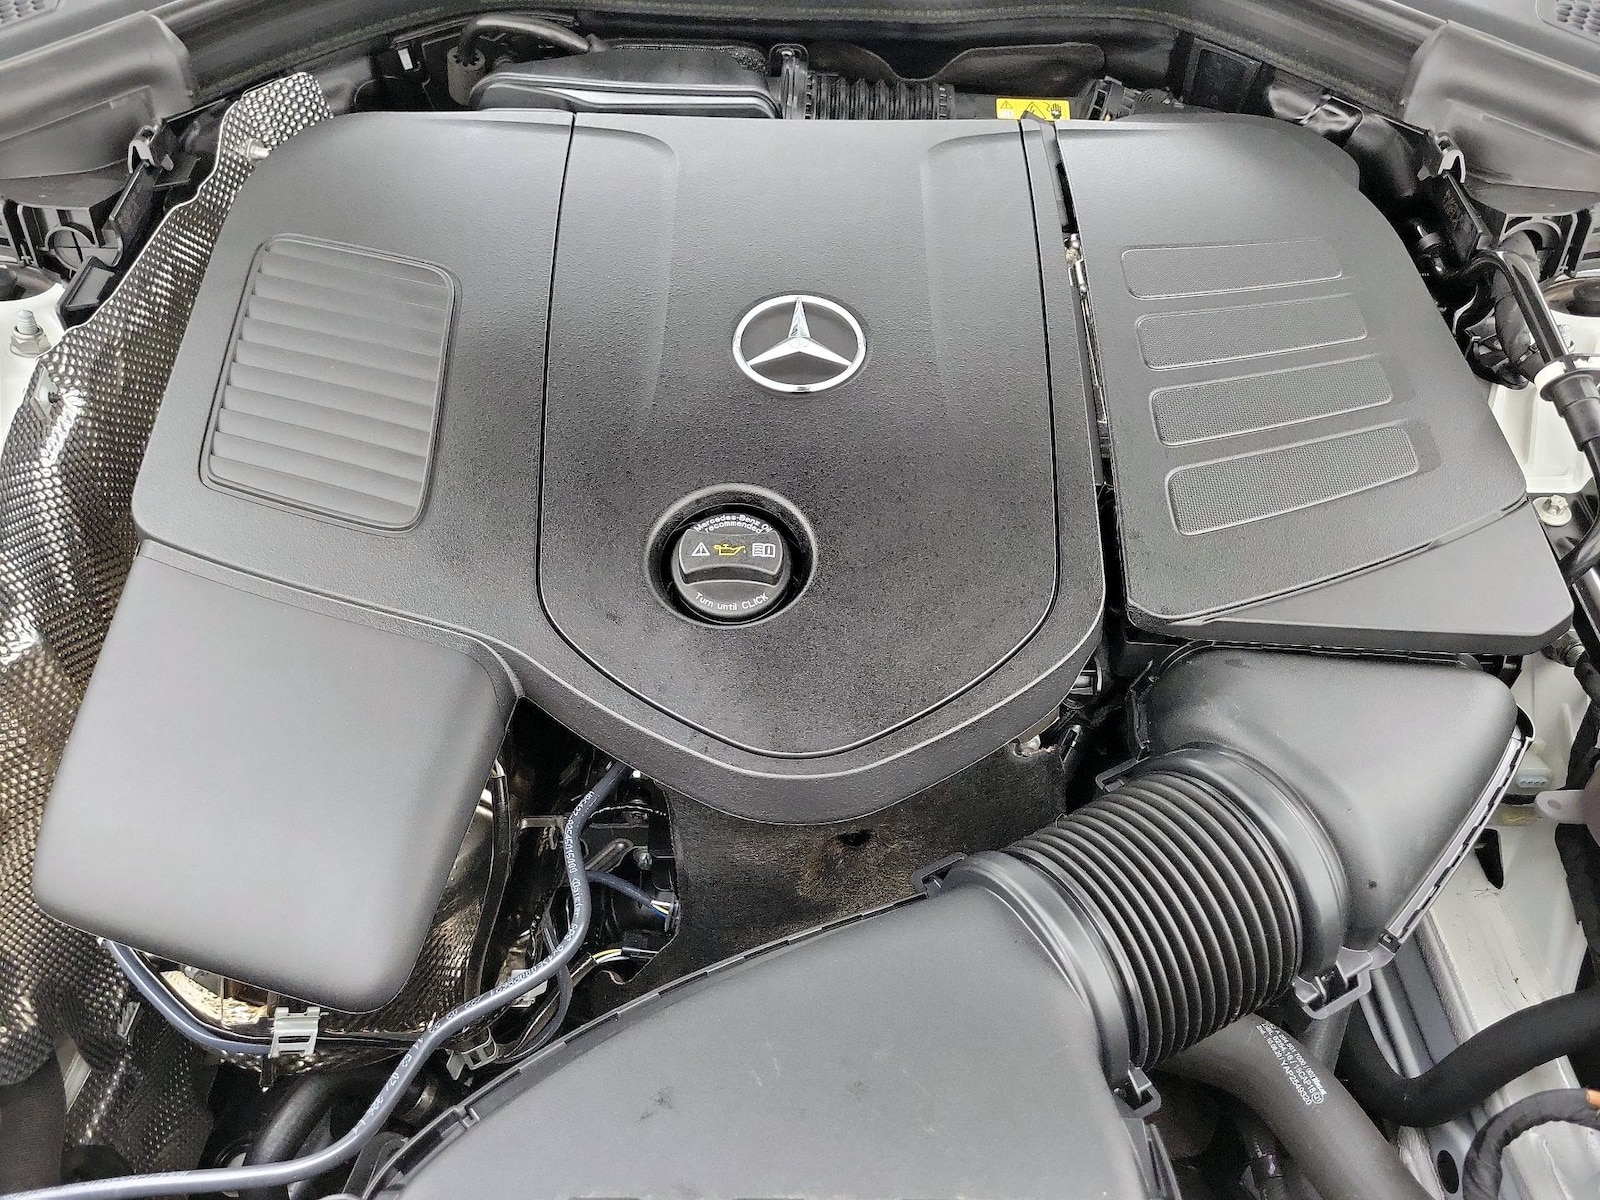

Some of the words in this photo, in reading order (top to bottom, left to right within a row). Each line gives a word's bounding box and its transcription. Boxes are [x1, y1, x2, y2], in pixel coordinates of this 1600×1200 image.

[693, 514, 761, 533] Mercedes-Benz
[761, 522, 773, 533] Oil
[704, 519, 764, 534] recommended
[694, 591, 714, 608] Turn
[717, 601, 738, 611] until
[741, 592, 770, 609] CLICK
